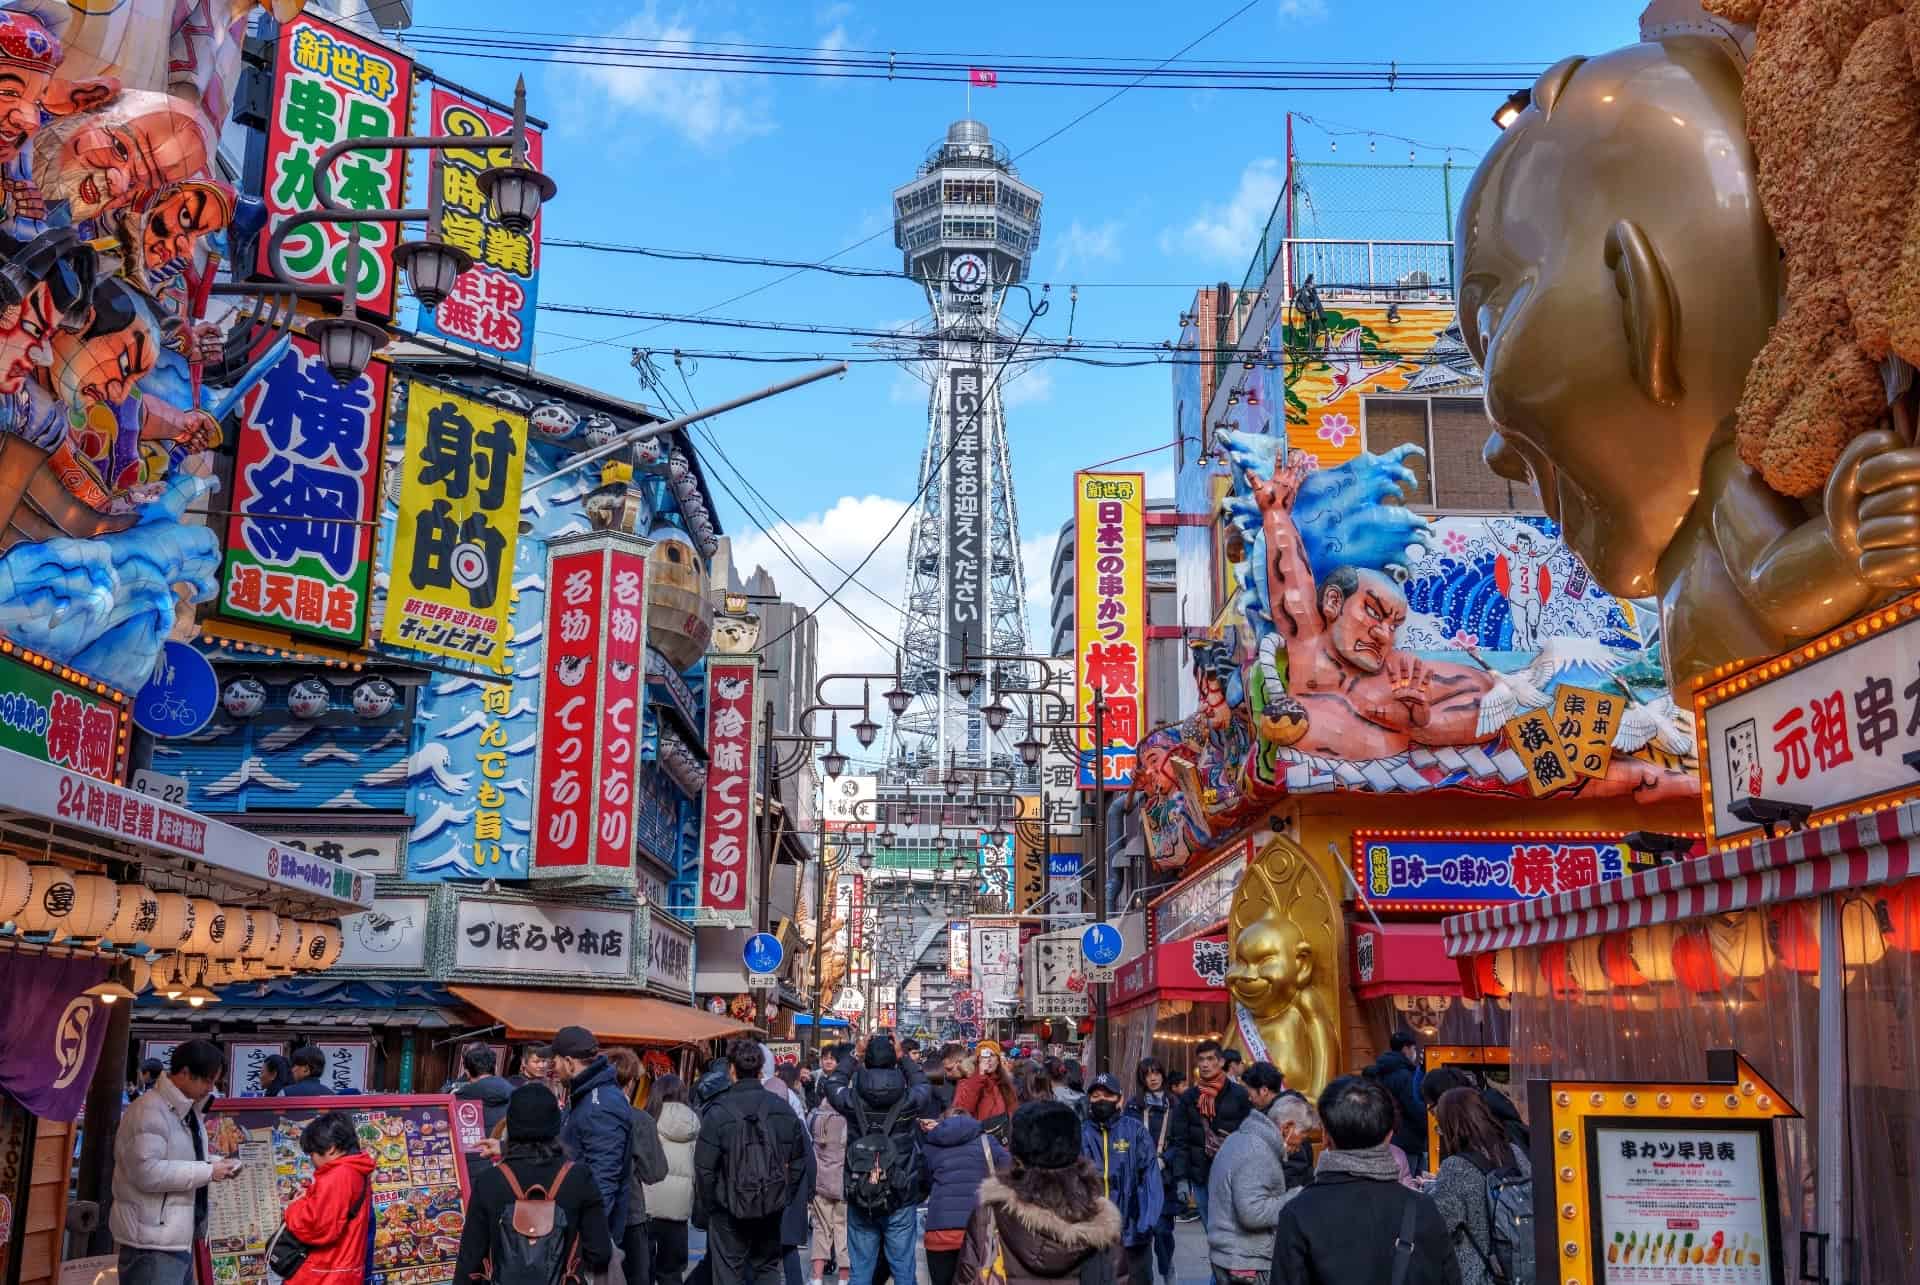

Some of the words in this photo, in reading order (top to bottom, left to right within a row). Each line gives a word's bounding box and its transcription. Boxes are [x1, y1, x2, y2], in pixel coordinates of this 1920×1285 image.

[294, 27, 396, 103] 新世界
[277, 79, 340, 277] 串かつ
[438, 301, 521, 348] 無休
[246, 348, 371, 578] 横綱
[1086, 480, 1134, 500] 新世界
[409, 402, 517, 609] 射的
[954, 375, 979, 623] 良いお年をお迎えください
[231, 564, 355, 631] 通天閣店
[560, 569, 592, 643] 名物
[612, 570, 640, 643] 名物
[1097, 502, 1126, 640] 日本一の串かつ
[399, 618, 496, 657] チャンピオン
[1084, 643, 1137, 748] 横綱
[1558, 693, 1586, 761] 串かつ
[49, 691, 114, 777] 横綱
[1518, 718, 1567, 788] 横綱
[1584, 700, 1612, 771] 日本一の
[57, 776, 155, 839] 24時間営業
[549, 696, 586, 849] てっちり
[601, 697, 634, 850] てっちり
[1371, 847, 1389, 895] 新世界
[1391, 856, 1509, 886] 日本一の串かつ
[1510, 846, 1598, 895] 横綱
[466, 920, 623, 958] づぼらや本店
[1195, 951, 1229, 975] 横
[1621, 1140, 1736, 1161] 串カツ早見表
